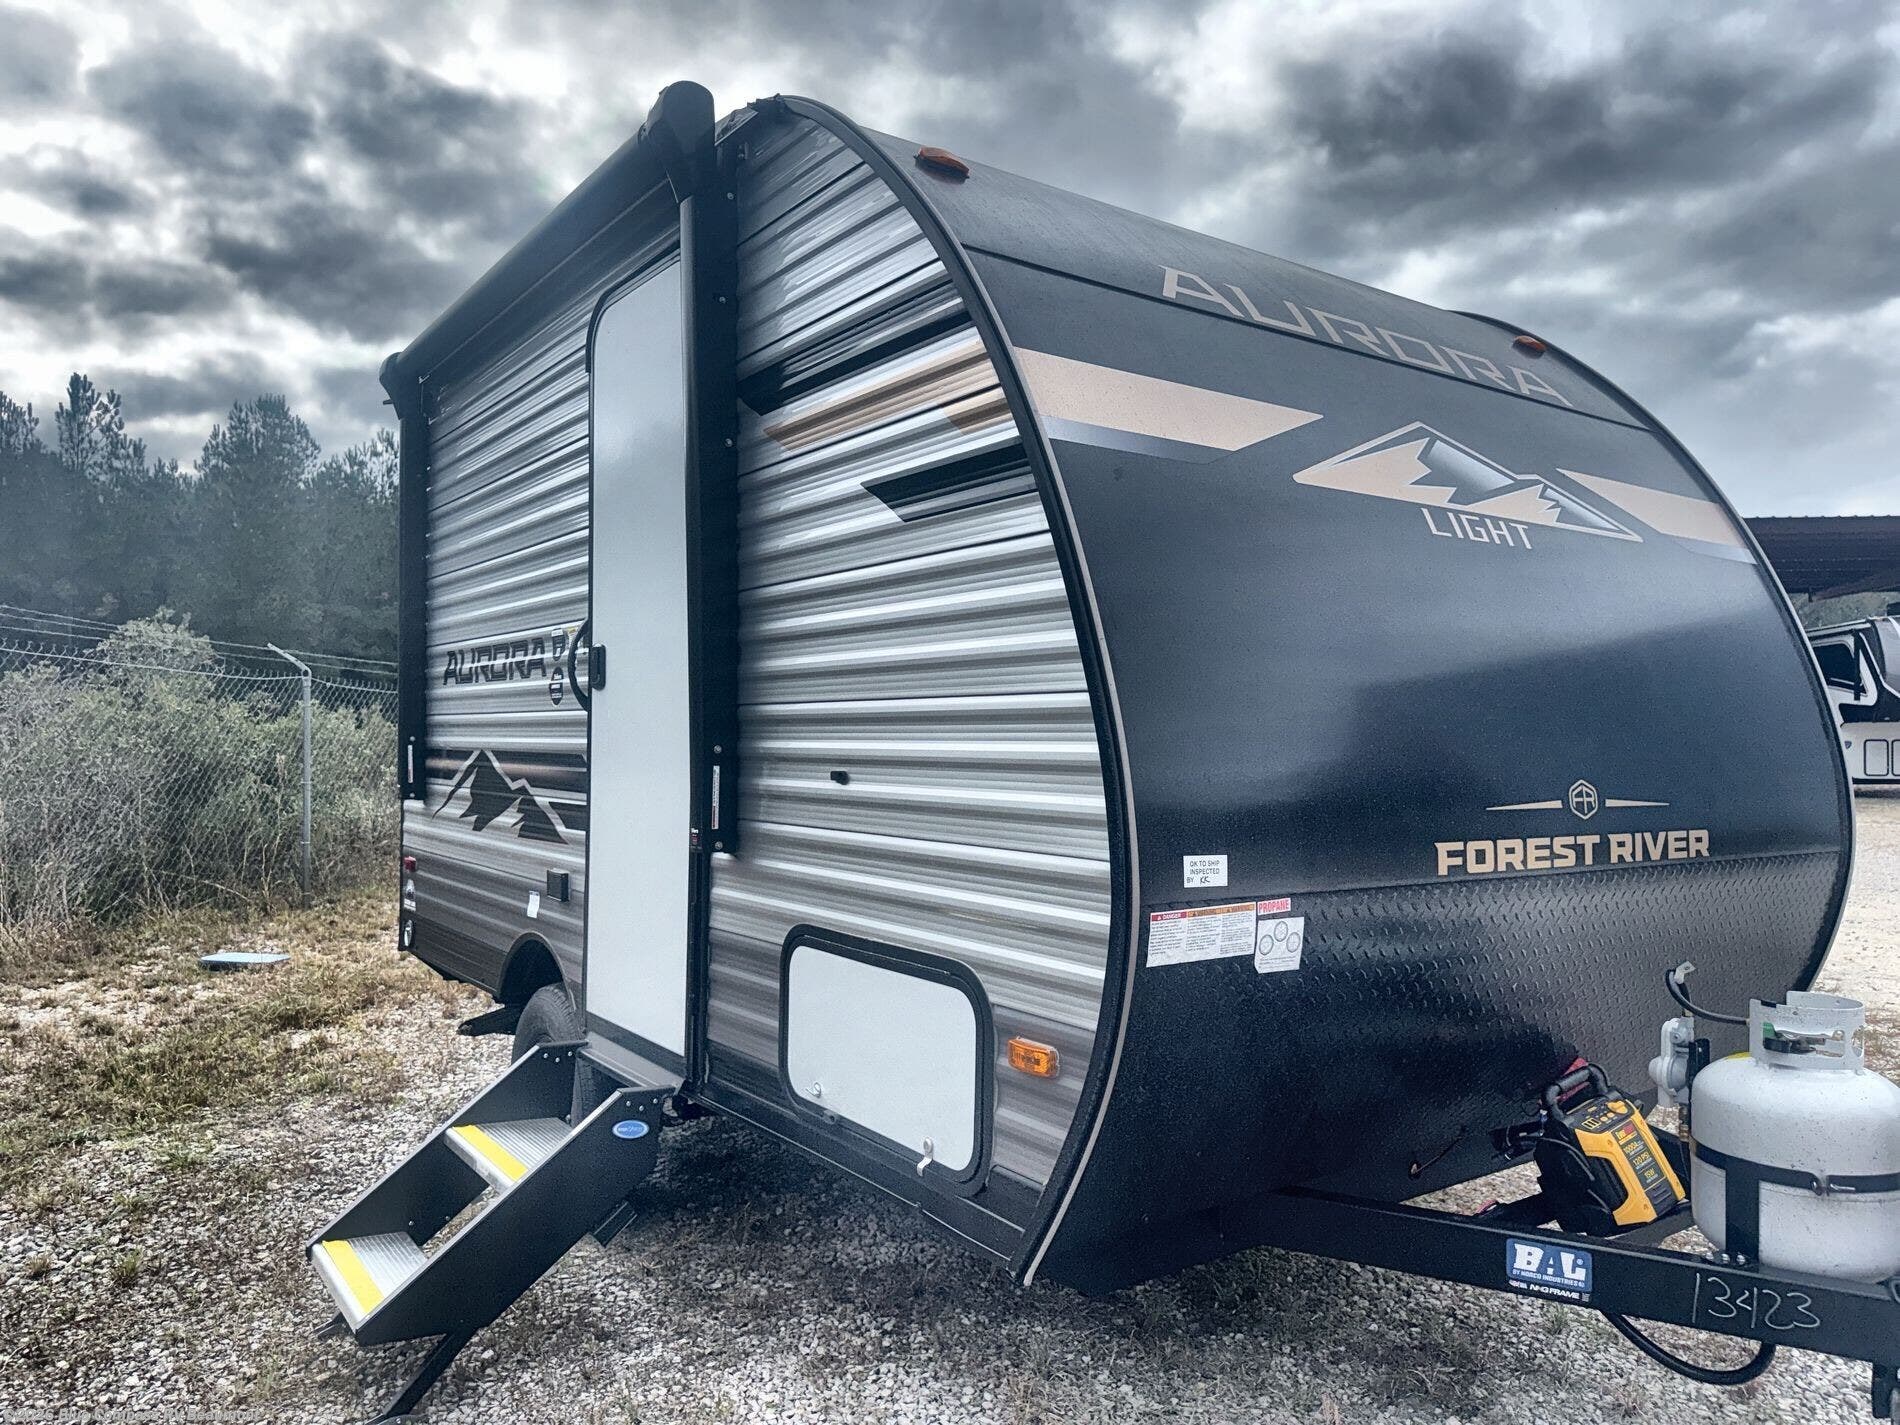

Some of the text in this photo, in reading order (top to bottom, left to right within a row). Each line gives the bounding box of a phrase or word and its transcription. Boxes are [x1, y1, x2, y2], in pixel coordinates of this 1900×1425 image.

[1159, 265, 1574, 407] AURORA
[1420, 507, 1533, 550] LIGHT
[443, 637, 547, 685] AURORA
[1434, 829, 1710, 876] FOREST RIVER
[1189, 859, 1220, 868] OK TO SHIP
[1189, 867, 1220, 875] INSPECTED
[1186, 876, 1195, 884] BY
[1258, 899, 1290, 914] PROPANE
[1162, 912, 1182, 921] DANGER
[1513, 1243, 1587, 1281] BAL
[1512, 1268, 1521, 1276] BY
[1549, 1288, 1580, 1300] FRAME
[1692, 1272, 1820, 1330] 13423
